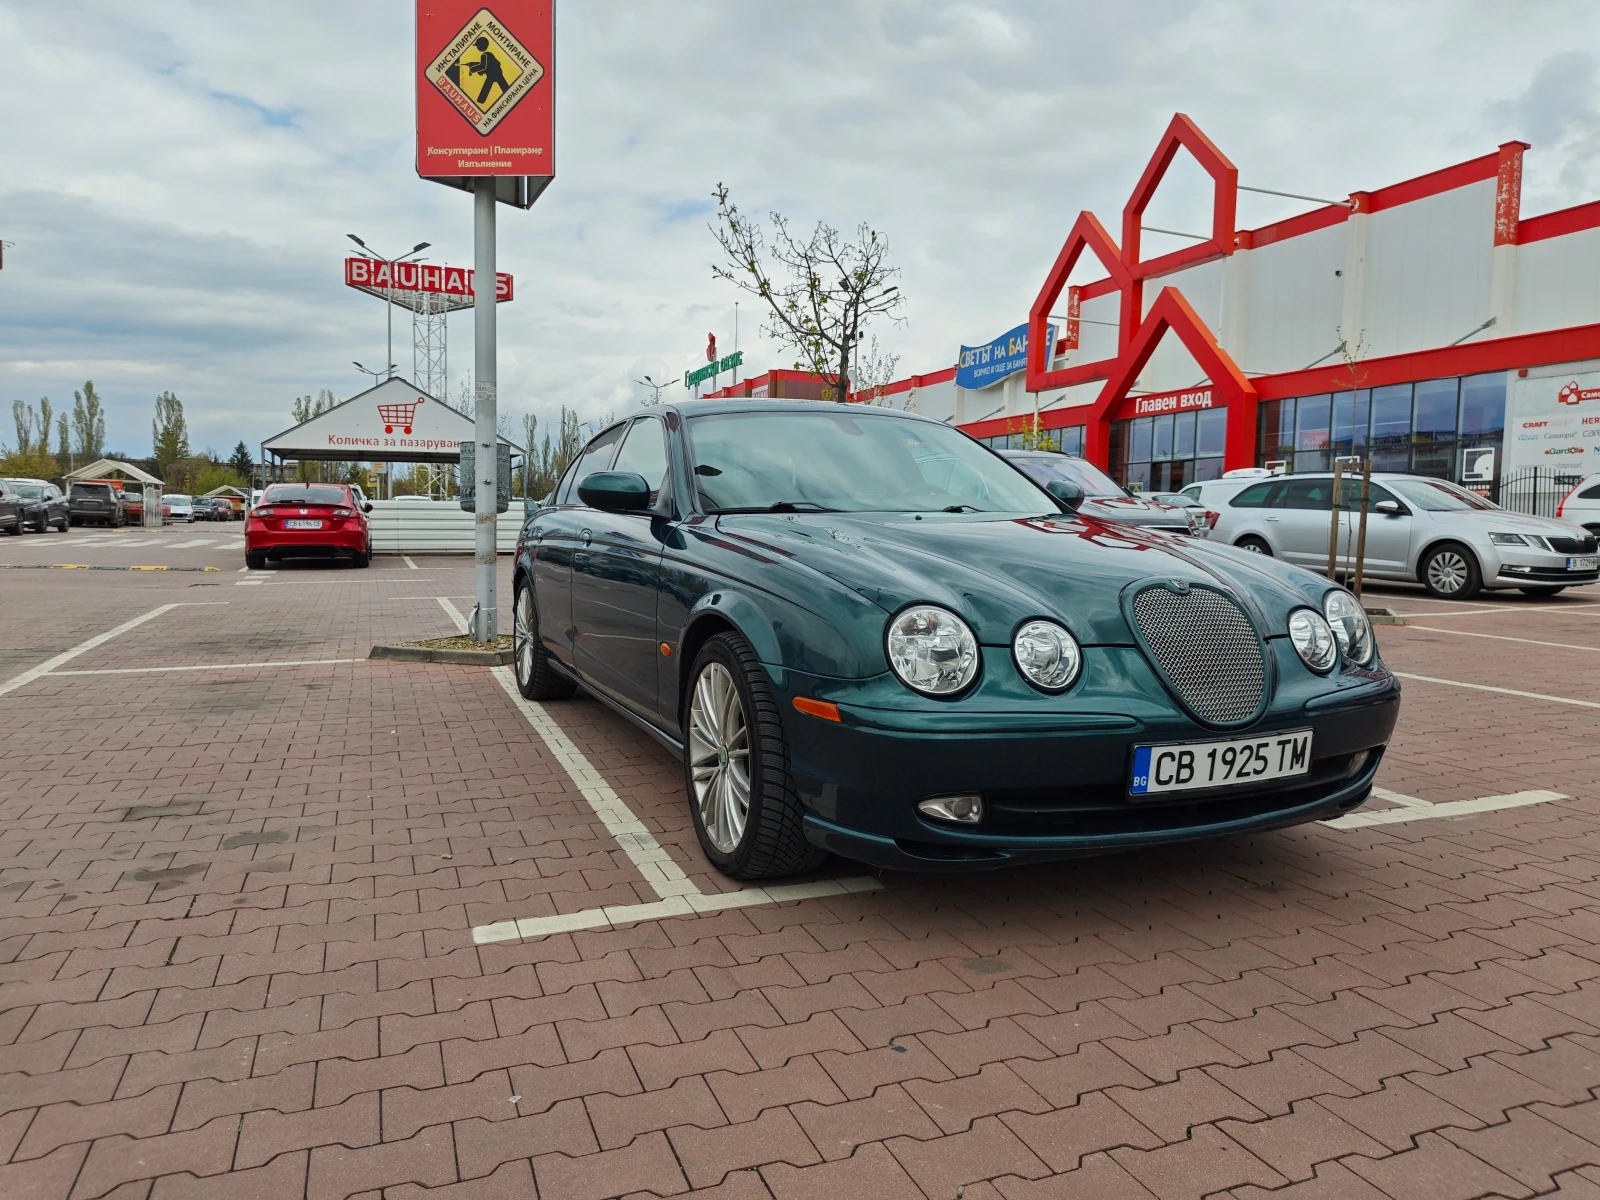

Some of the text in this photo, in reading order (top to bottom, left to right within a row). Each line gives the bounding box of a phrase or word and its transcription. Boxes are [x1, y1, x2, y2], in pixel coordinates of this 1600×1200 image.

[436, 21, 482, 73] ИНСТАЛИРАНЕ
[486, 21, 531, 69] МОНТИРАНЕ
[437, 76, 482, 124] BAUHAUS
[483, 68, 538, 128] НА ФИКСИРАНА ЦЕНА
[427, 146, 542, 156] Консултиране Планиране
[458, 159, 512, 168] Изпълнение
[351, 261, 508, 295] BAUHAS
[960, 344, 992, 369] СВЕТЪТ
[994, 344, 1006, 360] НА
[973, 365, 991, 378] ВСИЧКО
[995, 364, 1006, 374] ОЩЕ
[1006, 363, 1012, 371] ЗА
[1012, 358, 1028, 369] БАНЯТ
[1135, 390, 1212, 414] Главен вход
[328, 434, 460, 450] Количка за пазаруван
[1155, 736, 1308, 786] CB 1925 TM
[1133, 776, 1147, 787] BG
